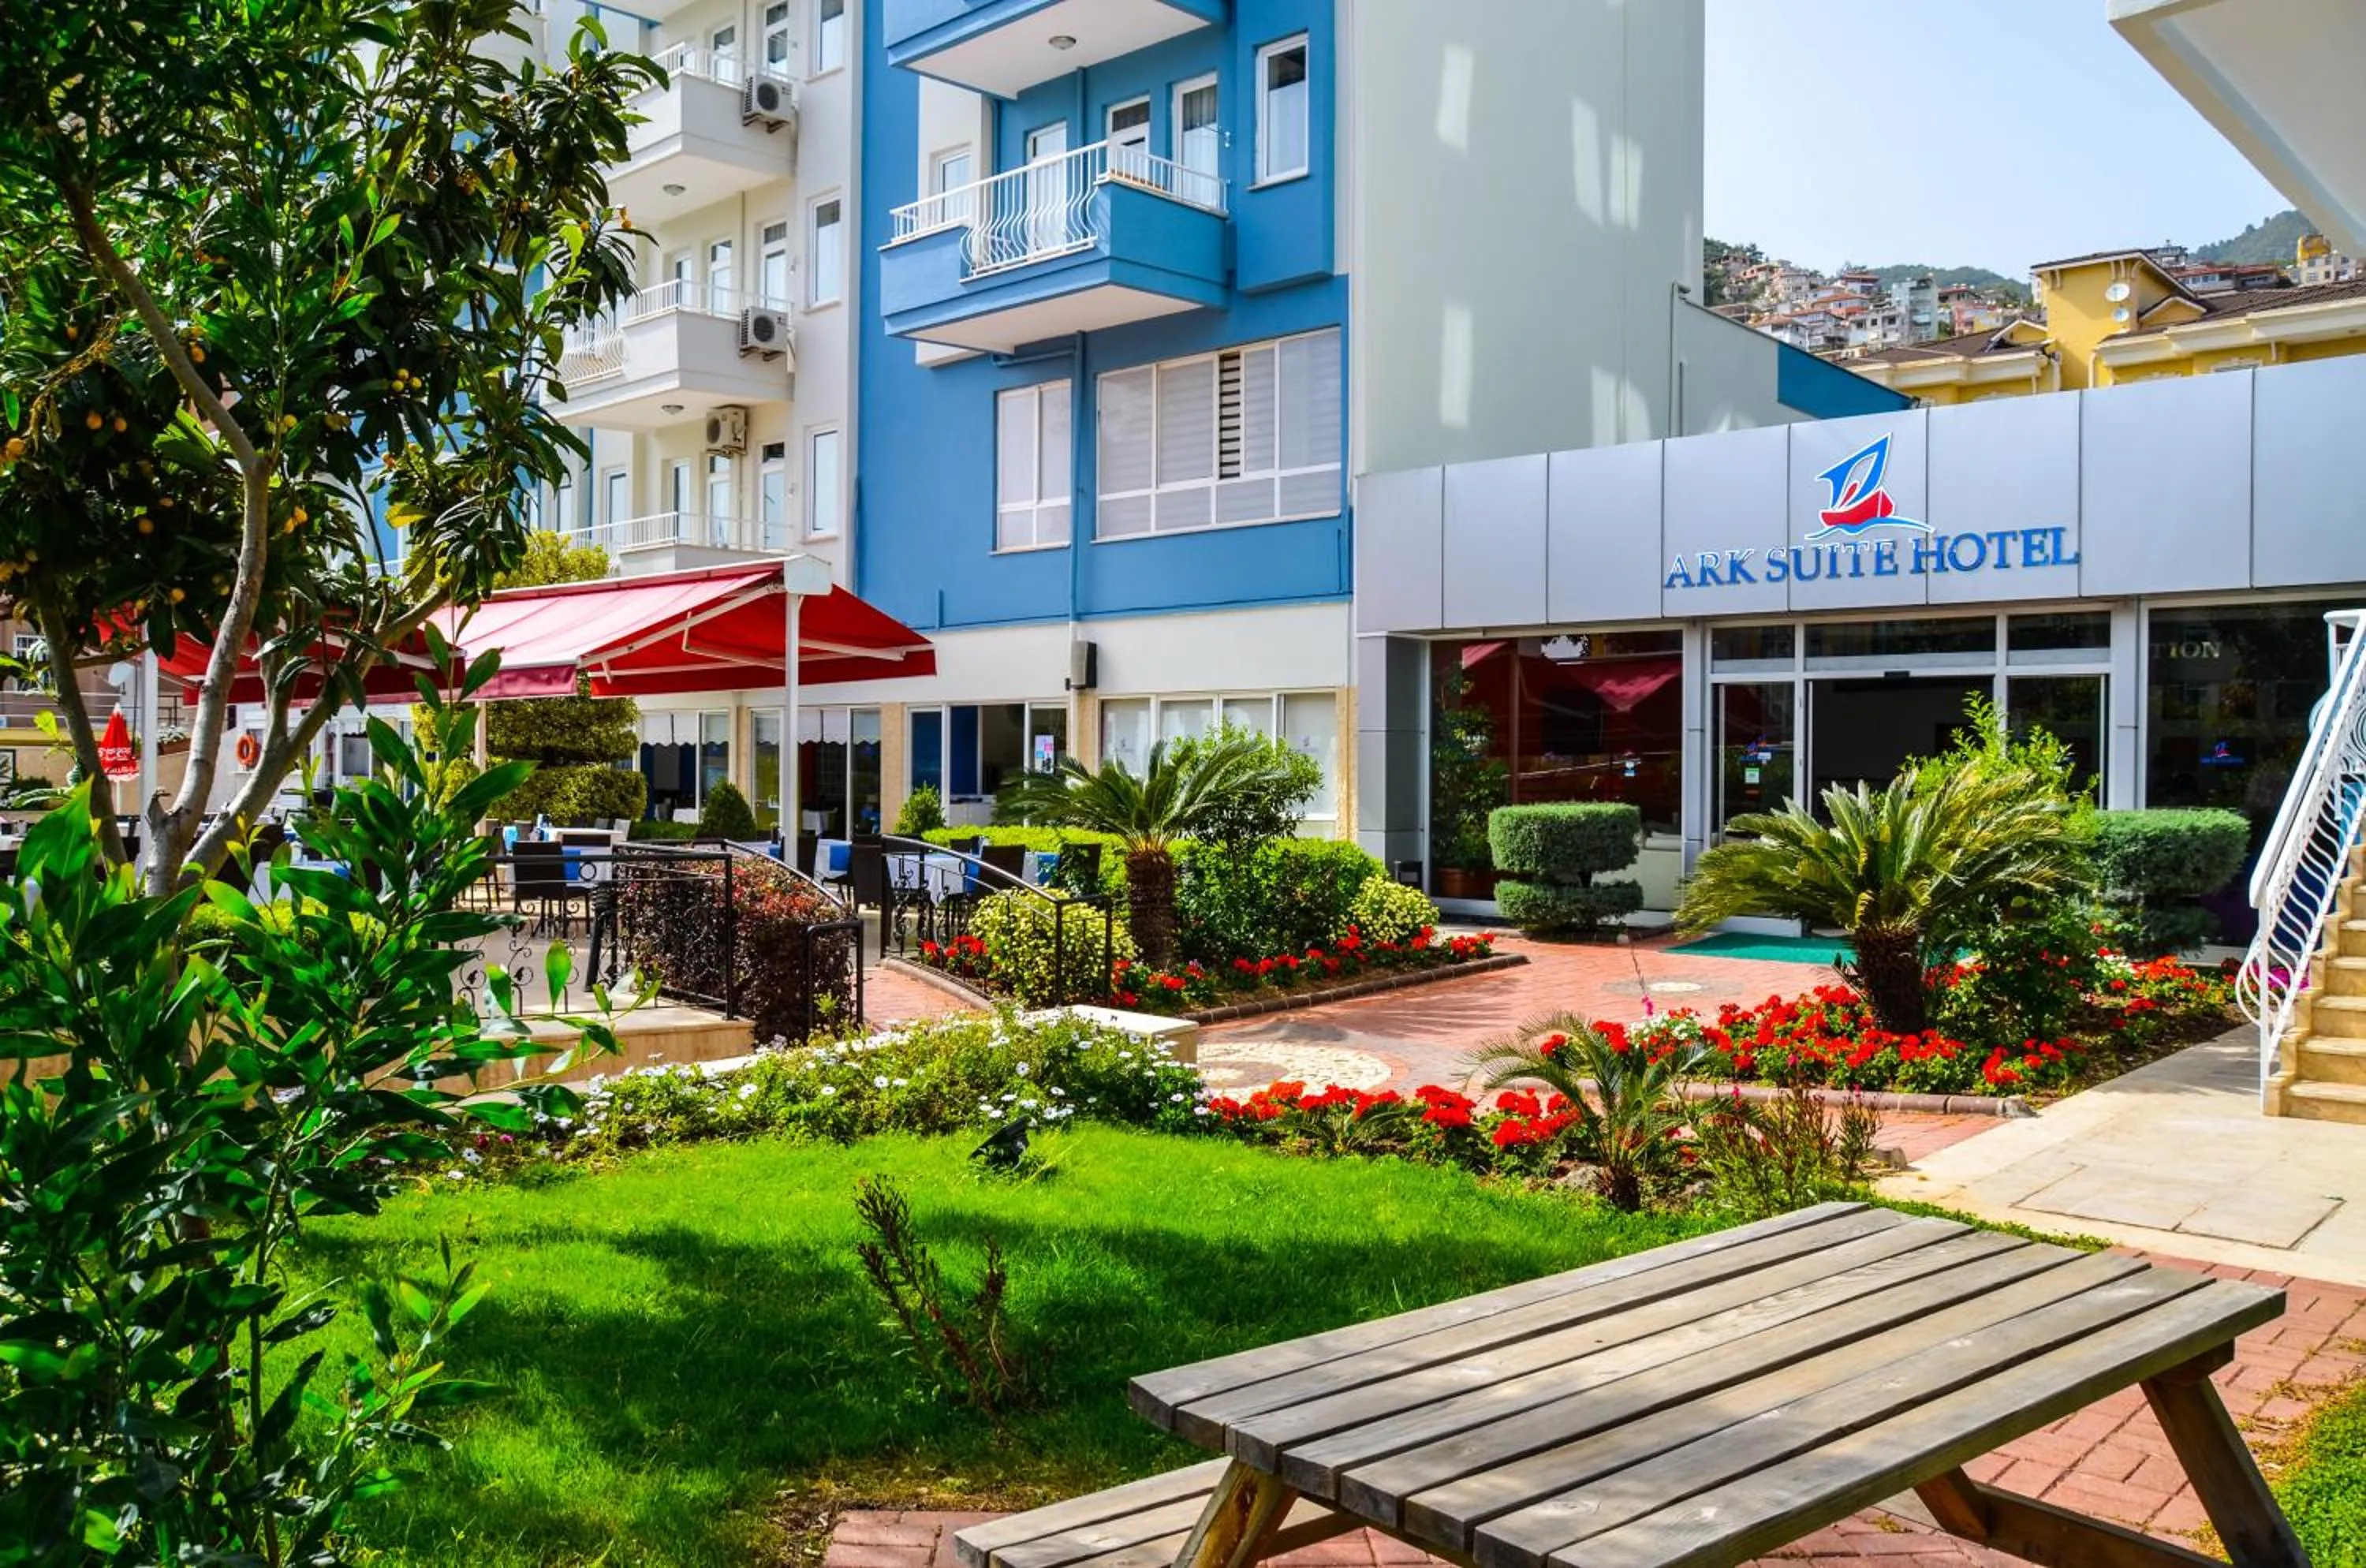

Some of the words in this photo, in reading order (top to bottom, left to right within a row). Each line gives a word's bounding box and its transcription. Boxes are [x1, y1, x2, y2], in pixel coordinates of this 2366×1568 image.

[1663, 548, 1757, 588] ARK
[1766, 539, 1898, 582] SUITE
[1909, 526, 2082, 574] HOTEL
